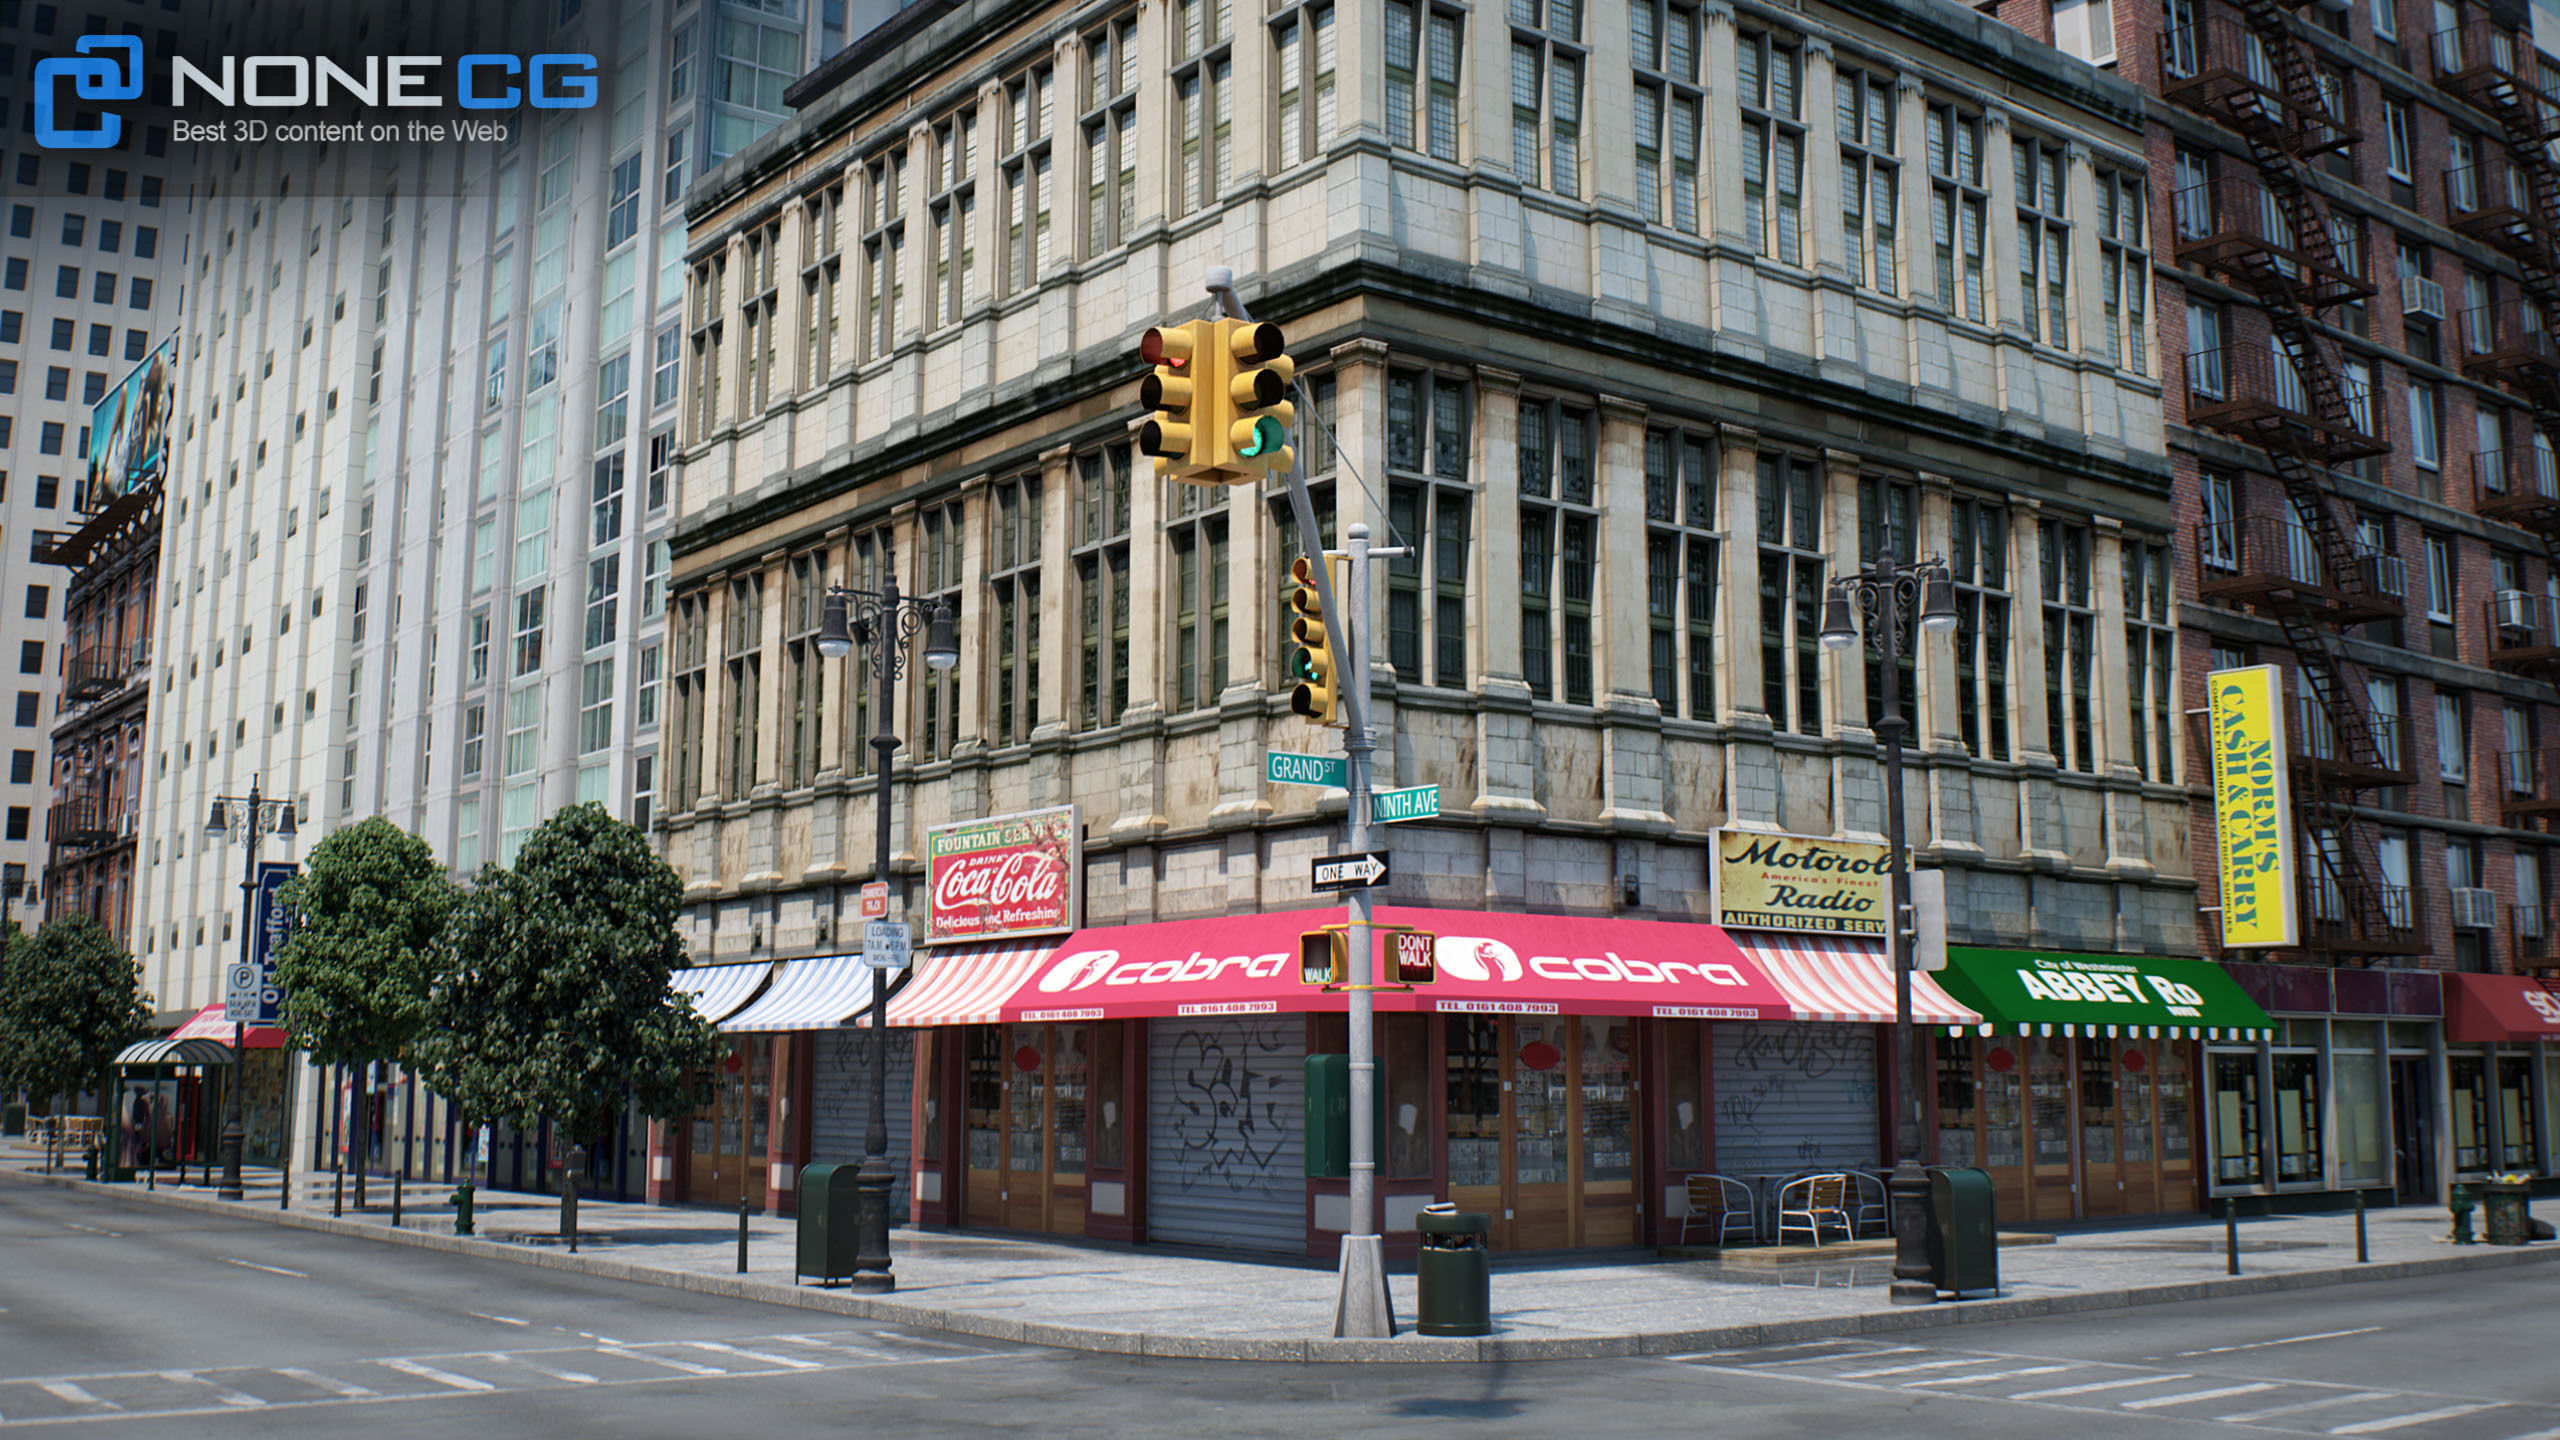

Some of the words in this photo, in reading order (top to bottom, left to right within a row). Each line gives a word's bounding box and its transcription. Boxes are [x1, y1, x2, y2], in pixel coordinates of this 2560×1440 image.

[2211, 680, 2222, 737] COMPLETE
[2221, 684, 2248, 777] CASH
[1272, 755, 1324, 782] GRAND
[1324, 761, 1336, 773] ST
[2215, 741, 2225, 796] PLUMBING
[1374, 792, 1412, 819] NINTH
[1414, 789, 1439, 814] AVE
[2227, 785, 2249, 803] &
[2249, 738, 2280, 873] NORM'S
[937, 831, 1001, 853] FOUNTAIN
[2219, 811, 2230, 876] ELECTRICAL
[968, 854, 1005, 866] DRINK
[1725, 838, 1909, 876] Motorol
[2228, 809, 2258, 928] CARRY
[1322, 864, 1344, 881] ONE
[1354, 862, 1378, 877] WAY
[1761, 871, 1828, 884] America's
[1836, 877, 1878, 887] Finest
[1765, 884, 1876, 912] Radio
[2224, 881, 2233, 934] SUPPLIES
[935, 915, 980, 929] Delicious
[1724, 911, 1837, 931] AUTHORIZED
[1843, 919, 1885, 934] SERV
[1398, 934, 1432, 951] DONT
[1105, 952, 1290, 986] cobra
[1398, 950, 1432, 967] WALK
[1529, 951, 1749, 986] cobra
[2034, 959, 2060, 971] City
[1304, 967, 1331, 983] WALK
[2016, 969, 2149, 1003] ABBEY
[1467, 1002, 1496, 1011] 0161
[1498, 1003, 1522, 1012] 408
[1524, 1004, 1557, 1013] 7993
[1678, 1008, 1704, 1016] 0161
[1704, 1008, 1725, 1017] 408
[1727, 1009, 1757, 1018] 7993
